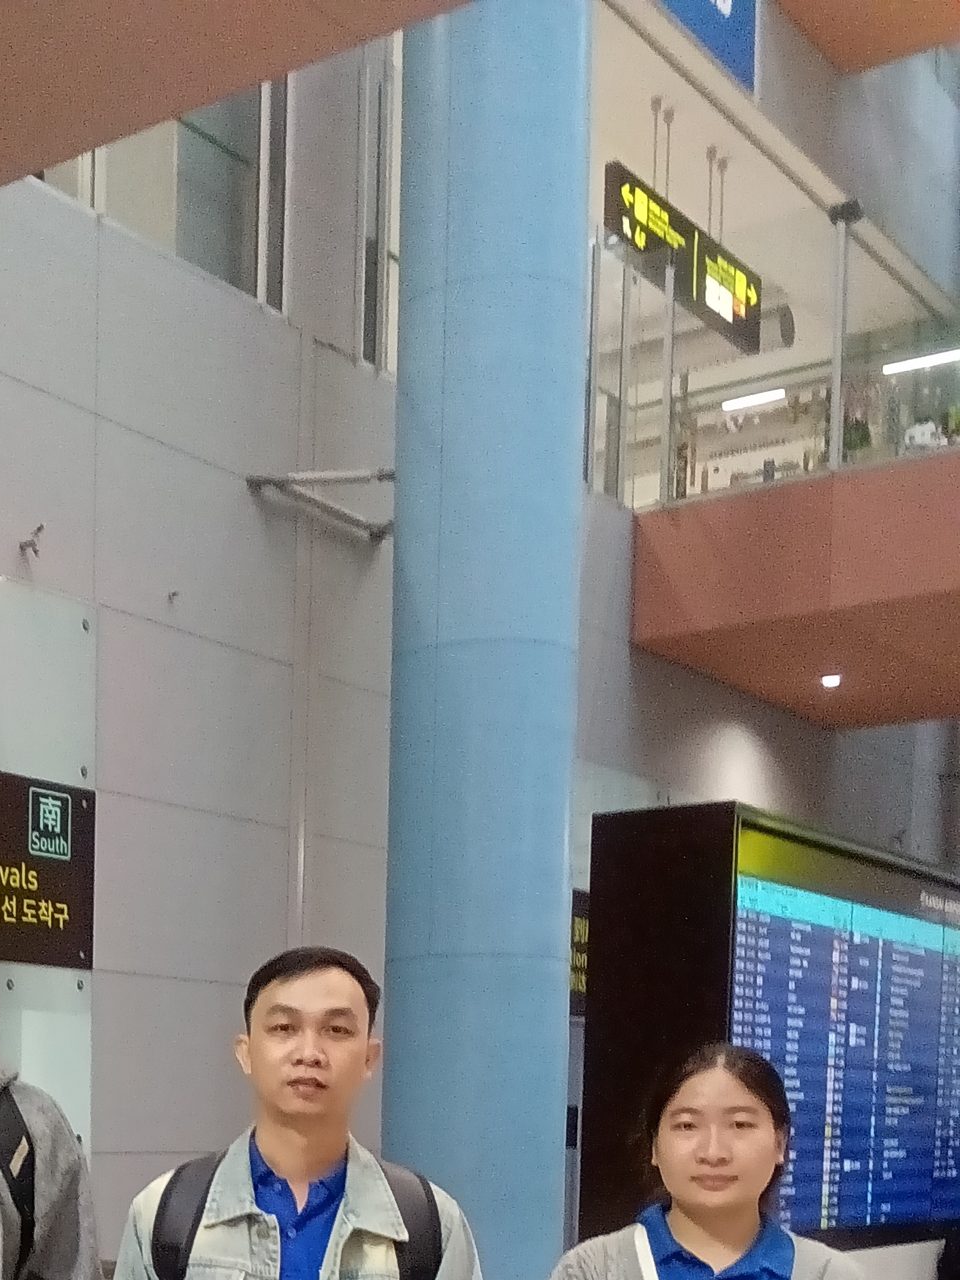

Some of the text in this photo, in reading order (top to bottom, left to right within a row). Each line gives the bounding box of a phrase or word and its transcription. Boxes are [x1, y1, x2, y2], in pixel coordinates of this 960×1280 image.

[39, 796, 62, 834] 南
[31, 831, 68, 853] South
[22, 898, 70, 930] 도착구
